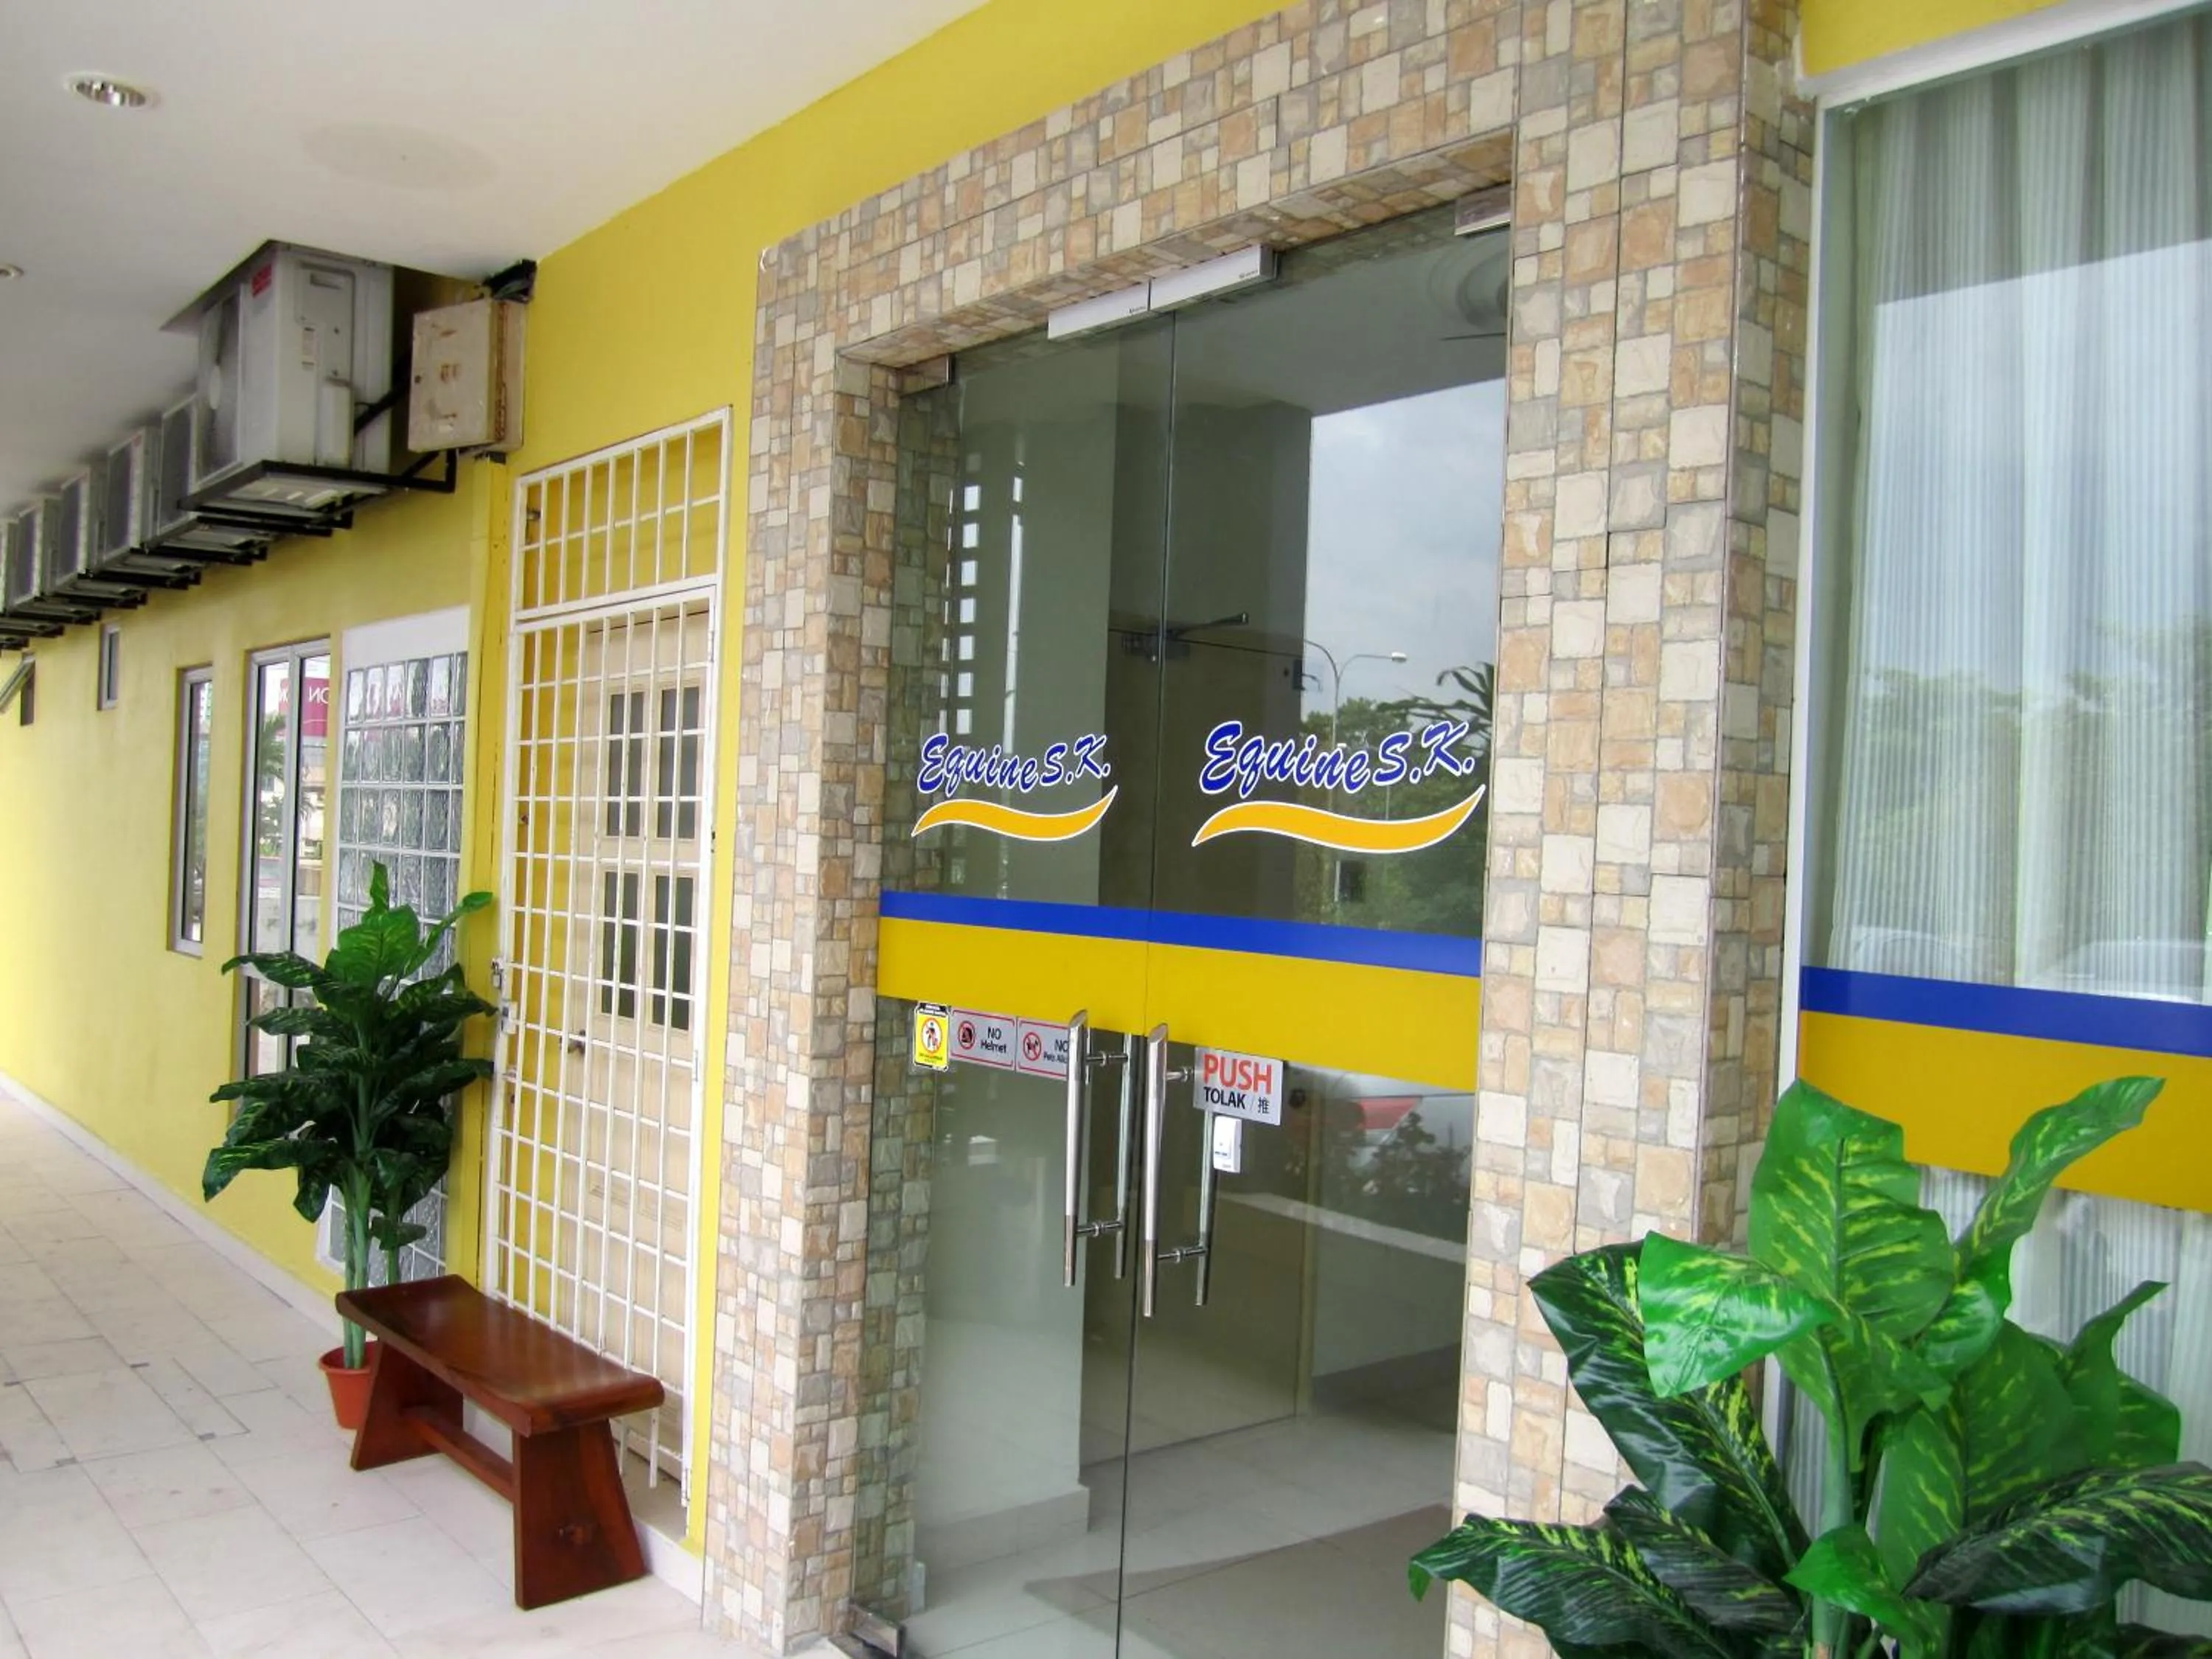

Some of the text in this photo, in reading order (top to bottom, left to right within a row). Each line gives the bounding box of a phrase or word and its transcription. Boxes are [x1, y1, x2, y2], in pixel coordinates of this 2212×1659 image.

[917, 732, 1036, 794] Equine
[1199, 720, 1372, 798] Equine
[981, 1040, 1007, 1054] Helmet
[987, 1027, 1002, 1040] NO
[1203, 1054, 1273, 1095] PUSH
[1203, 1086, 1246, 1110] TOLAK
[1258, 1096, 1270, 1114] 推
